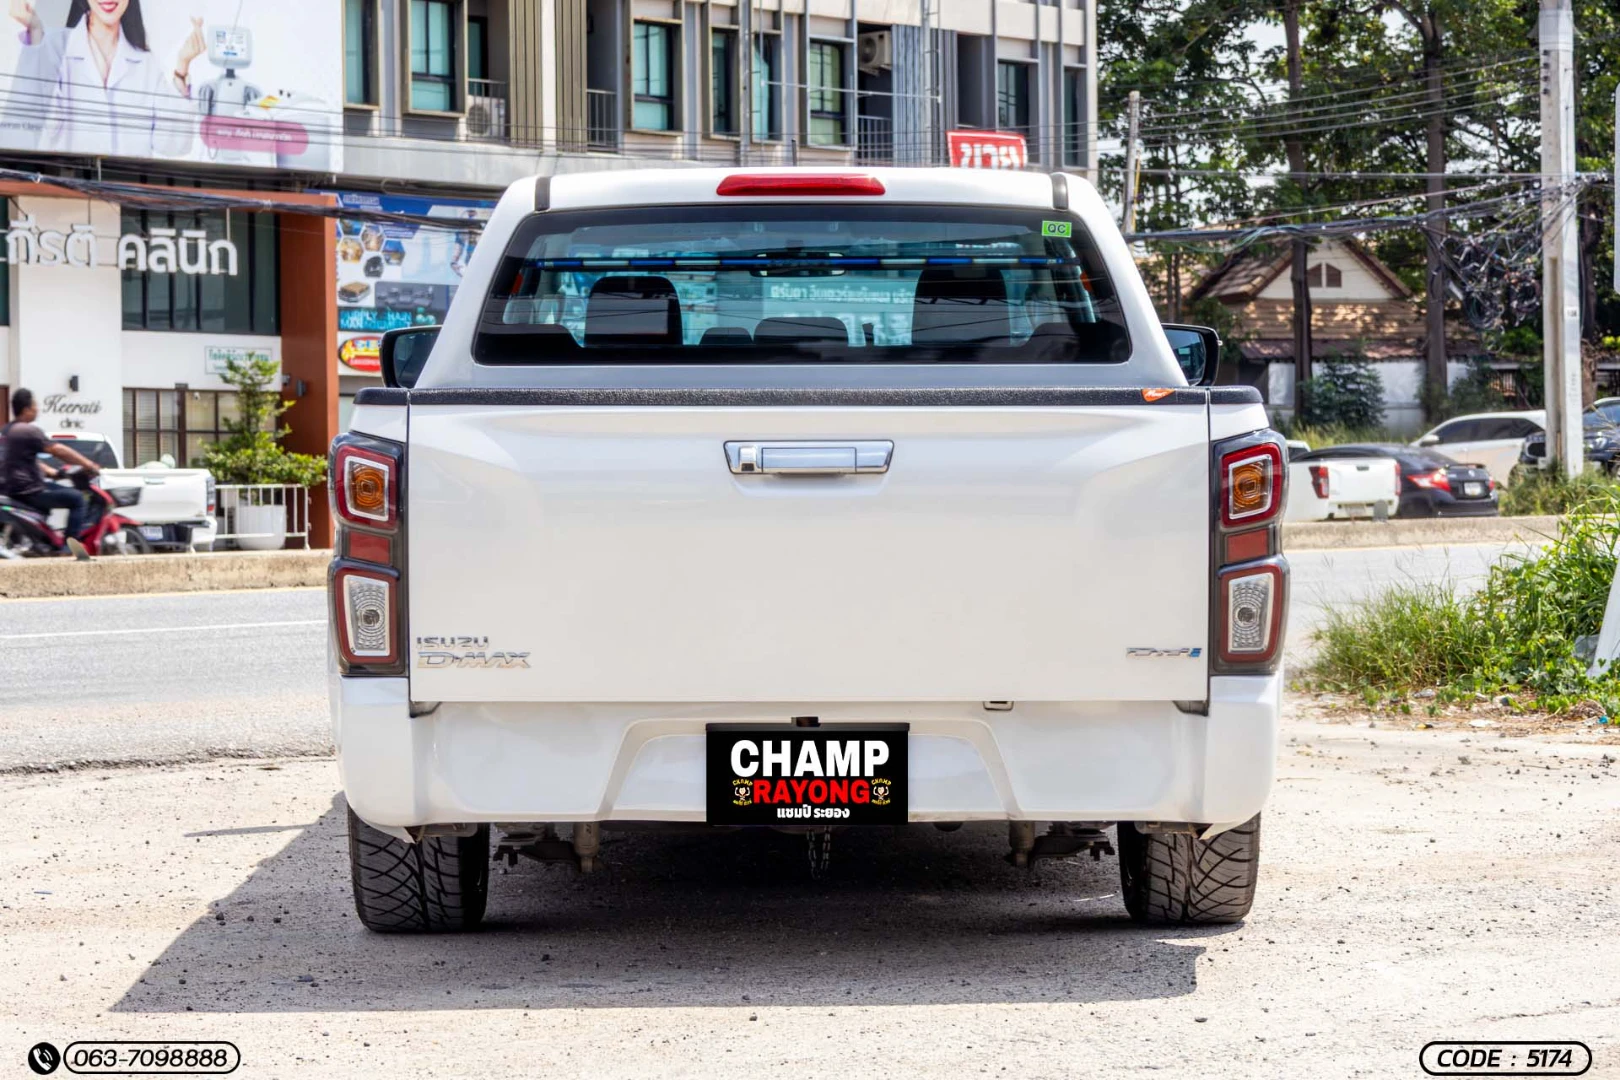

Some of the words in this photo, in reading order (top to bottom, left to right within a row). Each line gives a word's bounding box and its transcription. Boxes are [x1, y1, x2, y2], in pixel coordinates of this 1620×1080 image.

[1047, 223, 1066, 234] QC
[118, 228, 238, 276] คลินิก
[416, 636, 489, 650] ISUZU
